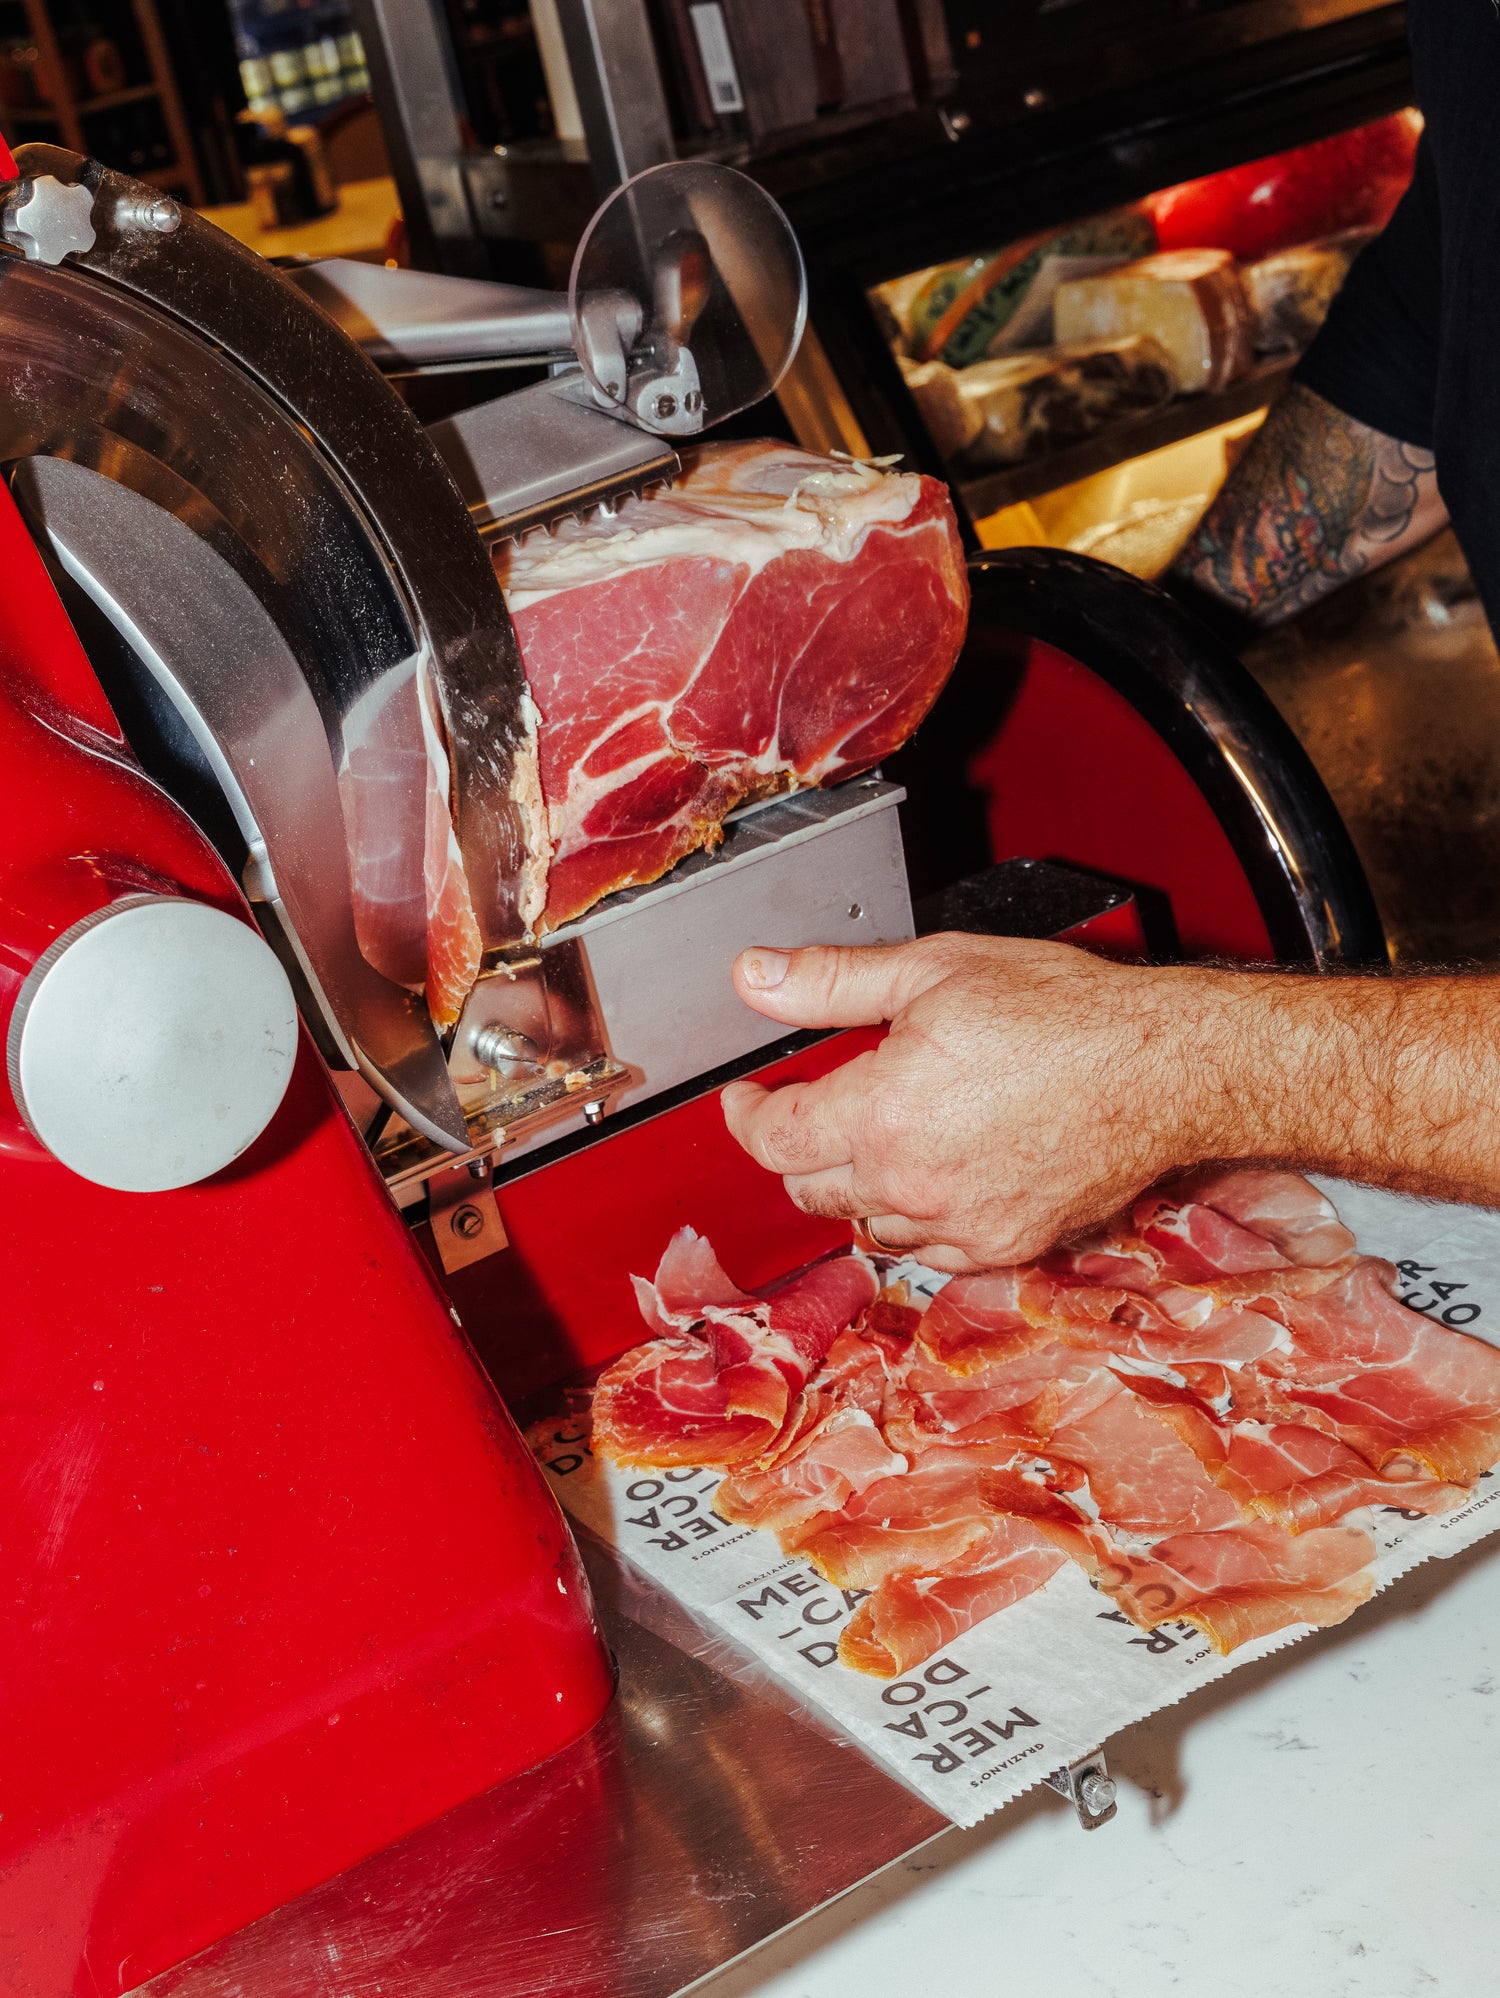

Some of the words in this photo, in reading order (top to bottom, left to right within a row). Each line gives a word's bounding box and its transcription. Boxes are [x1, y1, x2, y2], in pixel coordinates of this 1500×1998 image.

[545, 1448, 593, 1476] D
[737, 1557, 807, 1588] GRAZIANO
[797, 1640, 840, 1669] D
[881, 1657, 971, 1706] DO
[911, 1706, 1041, 1774] MER
[970, 1743, 1045, 1788] GRAZIANO'S
